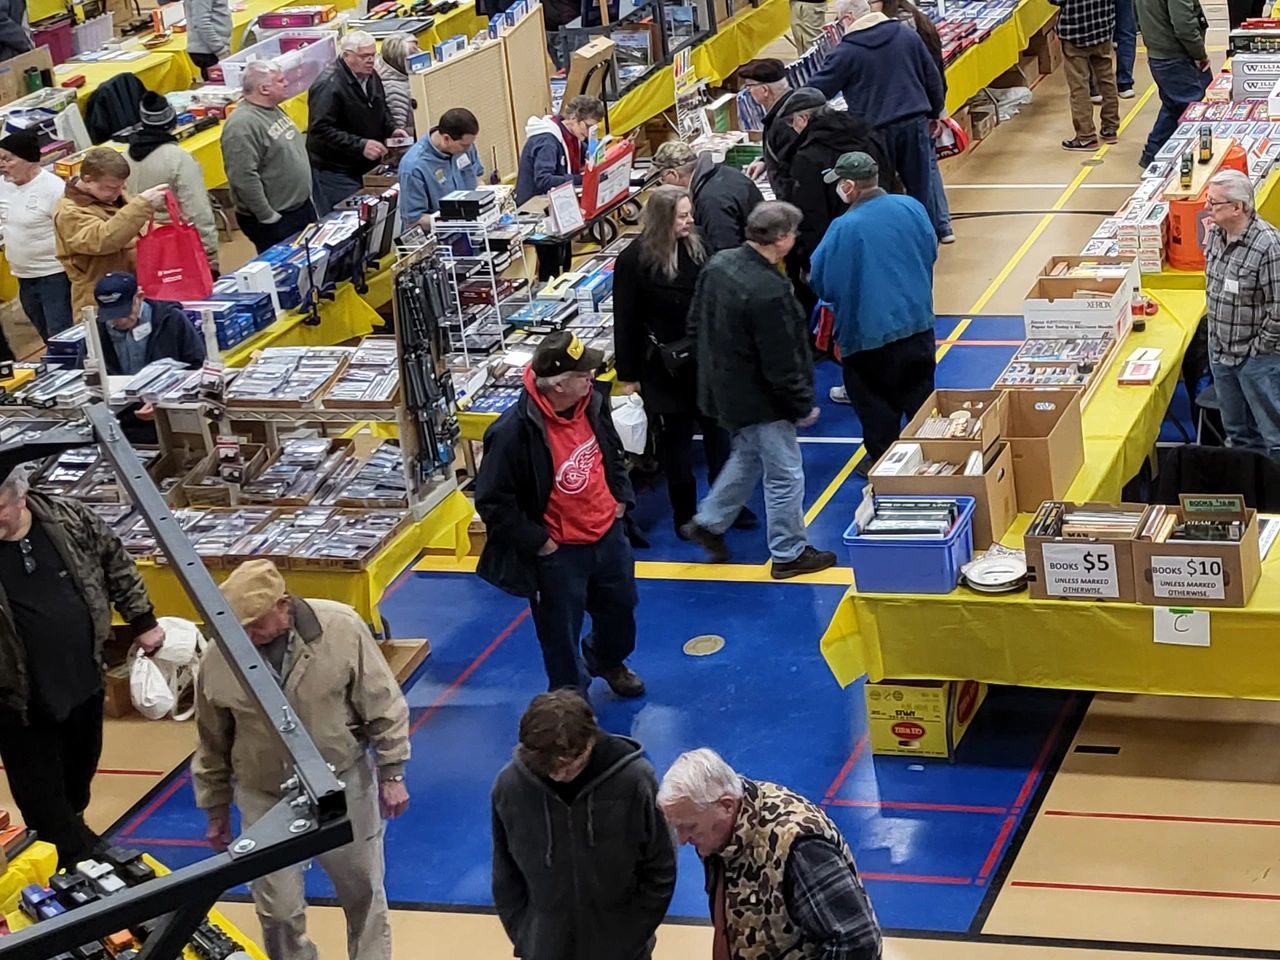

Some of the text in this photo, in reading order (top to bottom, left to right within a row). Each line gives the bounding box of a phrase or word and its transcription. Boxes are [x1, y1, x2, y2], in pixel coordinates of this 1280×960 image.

[1086, 301, 1112, 309] XEROX
[1050, 551, 1110, 574] BOOKS $5
[1152, 558, 1222, 578] BOOKS $10
[1054, 577, 1109, 586] UNLESS MARKED
[1160, 580, 1217, 589] UNLESS MARKED
[1062, 586, 1104, 595] OTHERWISE.
[1168, 589, 1210, 598] OTHERWISE.
[1174, 614, 1189, 632] C
